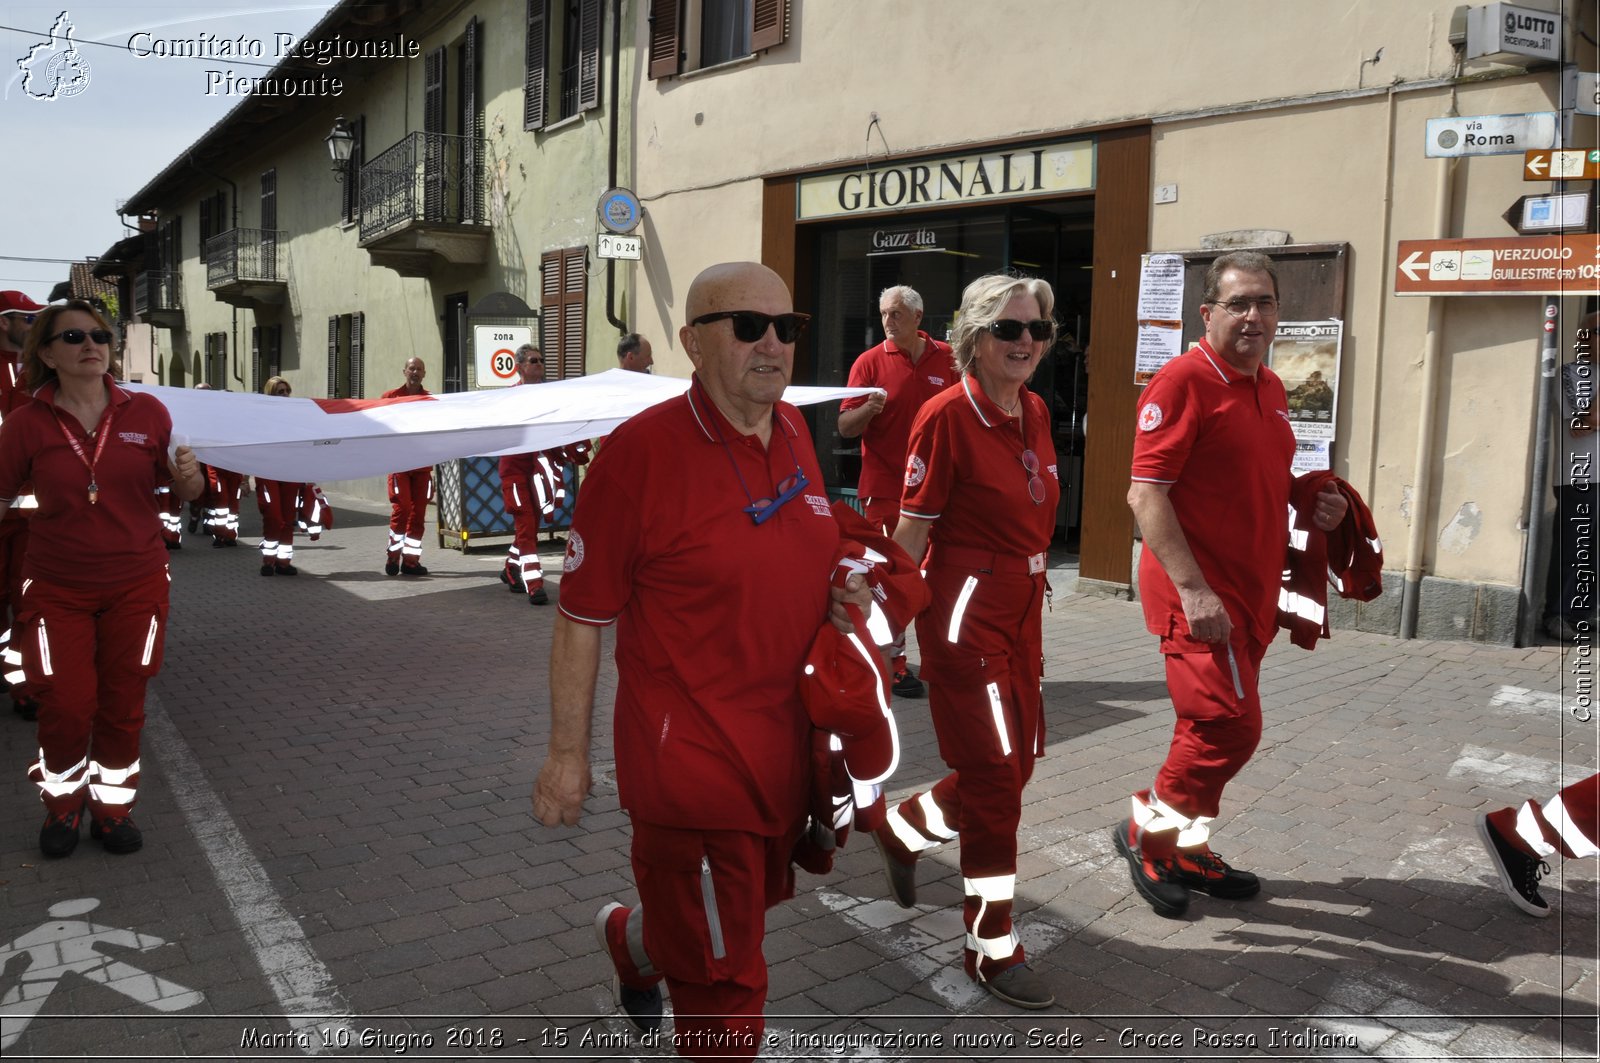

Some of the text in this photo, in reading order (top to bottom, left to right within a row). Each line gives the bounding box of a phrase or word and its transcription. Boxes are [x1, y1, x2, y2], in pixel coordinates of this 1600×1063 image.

[1517, 14, 1555, 35] LOTTO
[1466, 121, 1483, 131] via
[1465, 133, 1515, 146] Roma
[838, 150, 1046, 211] GIORNALI
[1162, 187, 1169, 200] 2
[873, 227, 936, 248] Gazzetta
[616, 243, 635, 252] 0 24
[1494, 247, 1573, 261] VERZUOLO
[1493, 267, 1556, 280] GUILLESTRE
[1557, 268, 1576, 281] (FR)
[493, 333, 514, 341] zona
[496, 356, 513, 371] 30
